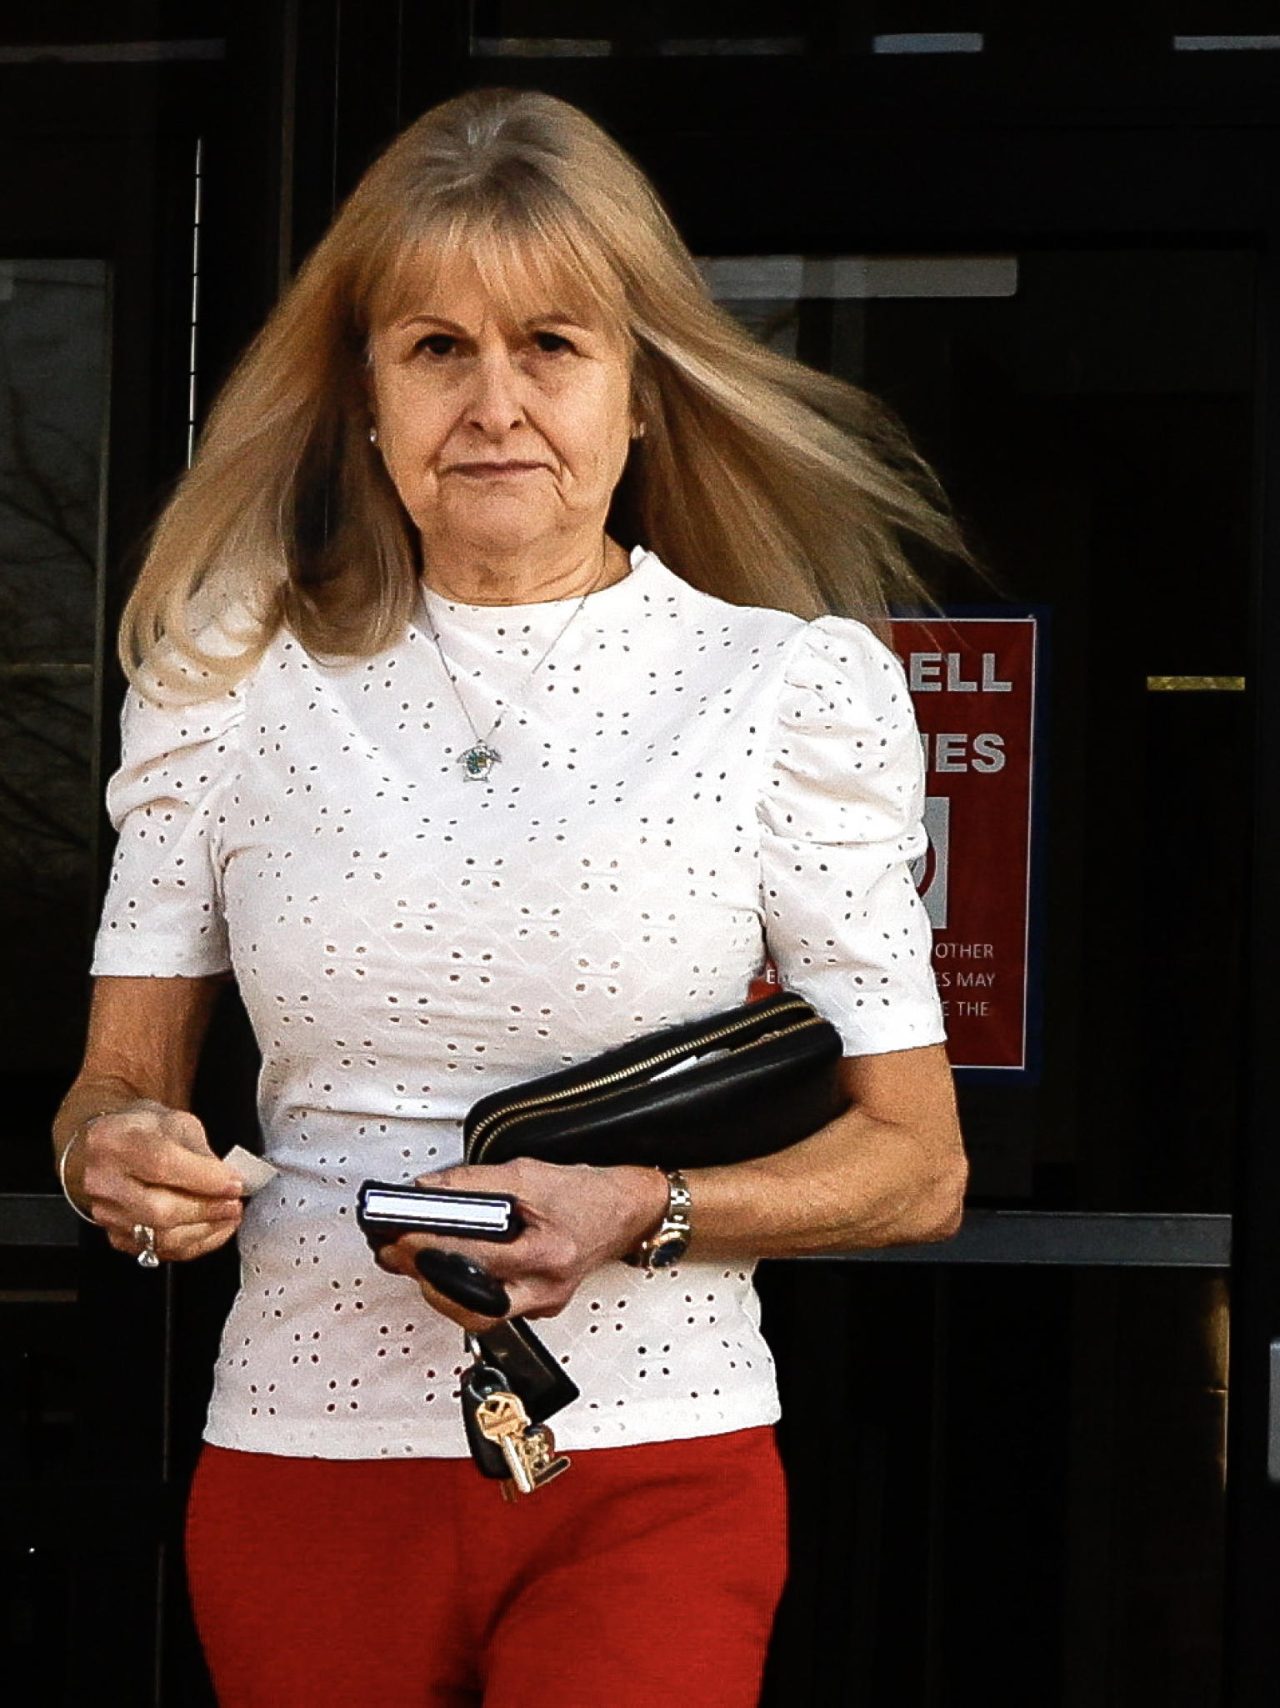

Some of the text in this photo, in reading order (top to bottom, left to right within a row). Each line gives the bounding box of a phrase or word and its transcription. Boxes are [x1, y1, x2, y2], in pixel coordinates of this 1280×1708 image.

[909, 652, 1013, 692] ELL
[935, 942, 994, 959] OTHER
[956, 971, 996, 988] MAY
[956, 1001, 991, 1017] THE
